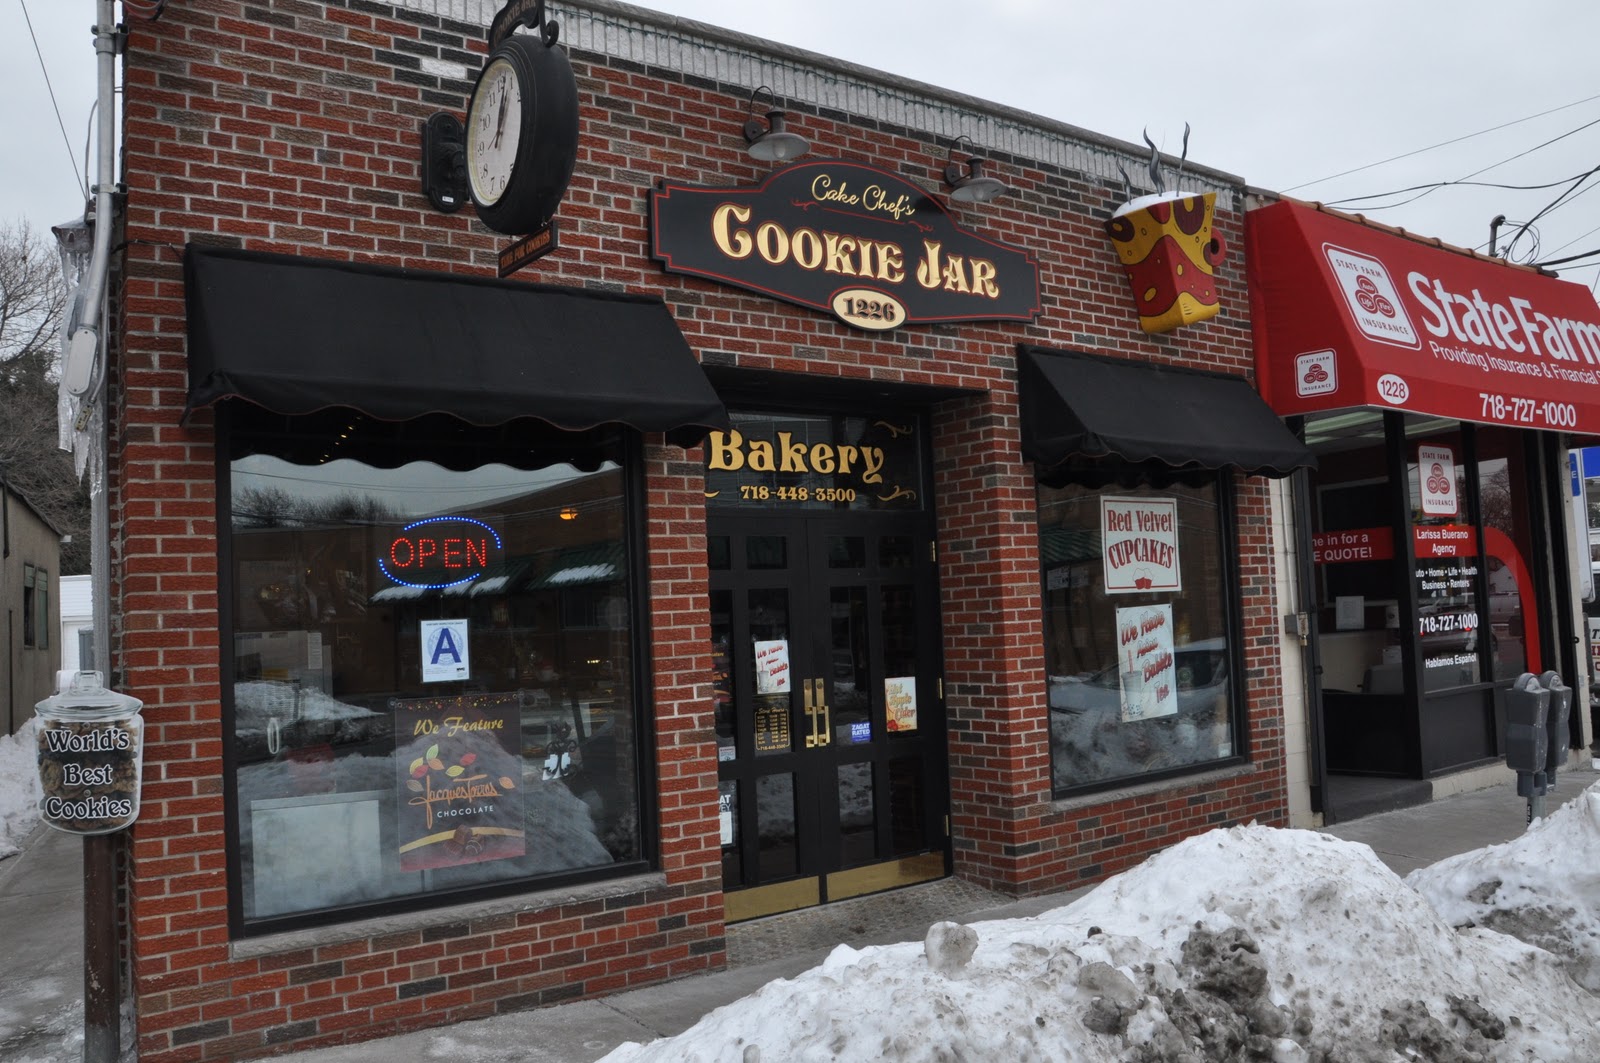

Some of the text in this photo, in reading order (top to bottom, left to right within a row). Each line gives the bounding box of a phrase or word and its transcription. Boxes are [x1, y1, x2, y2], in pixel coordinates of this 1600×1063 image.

[811, 174, 916, 220] Cake Chef's
[712, 203, 999, 299] COOKIE JAR
[1335, 259, 1383, 279] STATE FARM
[842, 296, 896, 323] 1226
[1360, 317, 1409, 335] INSURANCE
[1428, 340, 1490, 372] Providing
[1486, 352, 1543, 378] Insurance
[1541, 361, 1553, 379] &
[1550, 363, 1599, 385] Financial
[1380, 379, 1406, 399] 1228
[1479, 393, 1577, 428] 718-727-1000
[708, 429, 885, 484] Bakery
[740, 485, 856, 502] 718-448-3500
[1107, 509, 1173, 532] Red Velvet
[1327, 535, 1338, 545] in
[1341, 533, 1358, 544] for
[1361, 534, 1369, 543] a
[1416, 529, 1441, 539] Larissa
[391, 538, 487, 568] OPEN
[1108, 537, 1174, 570] CUPCAKES
[1324, 547, 1373, 561] QUOTE!
[1432, 543, 1457, 556] Agency
[1415, 569, 1425, 578] uto
[1428, 567, 1445, 577] Home
[1421, 580, 1447, 590] Business
[1121, 611, 1165, 646] We Have
[1418, 613, 1479, 633] 718-727-1000
[430, 627, 462, 665] A
[1142, 648, 1173, 682] Bubble
[1425, 657, 1454, 669] Hablamos
[413, 716, 504, 737] We Feature
[851, 722, 871, 731] ZAGAT
[851, 729, 871, 737] RATED
[45, 728, 130, 752] World's
[63, 763, 113, 786] Best
[45, 796, 131, 819] Cookies
[437, 804, 495, 818] CHOCOLATE
